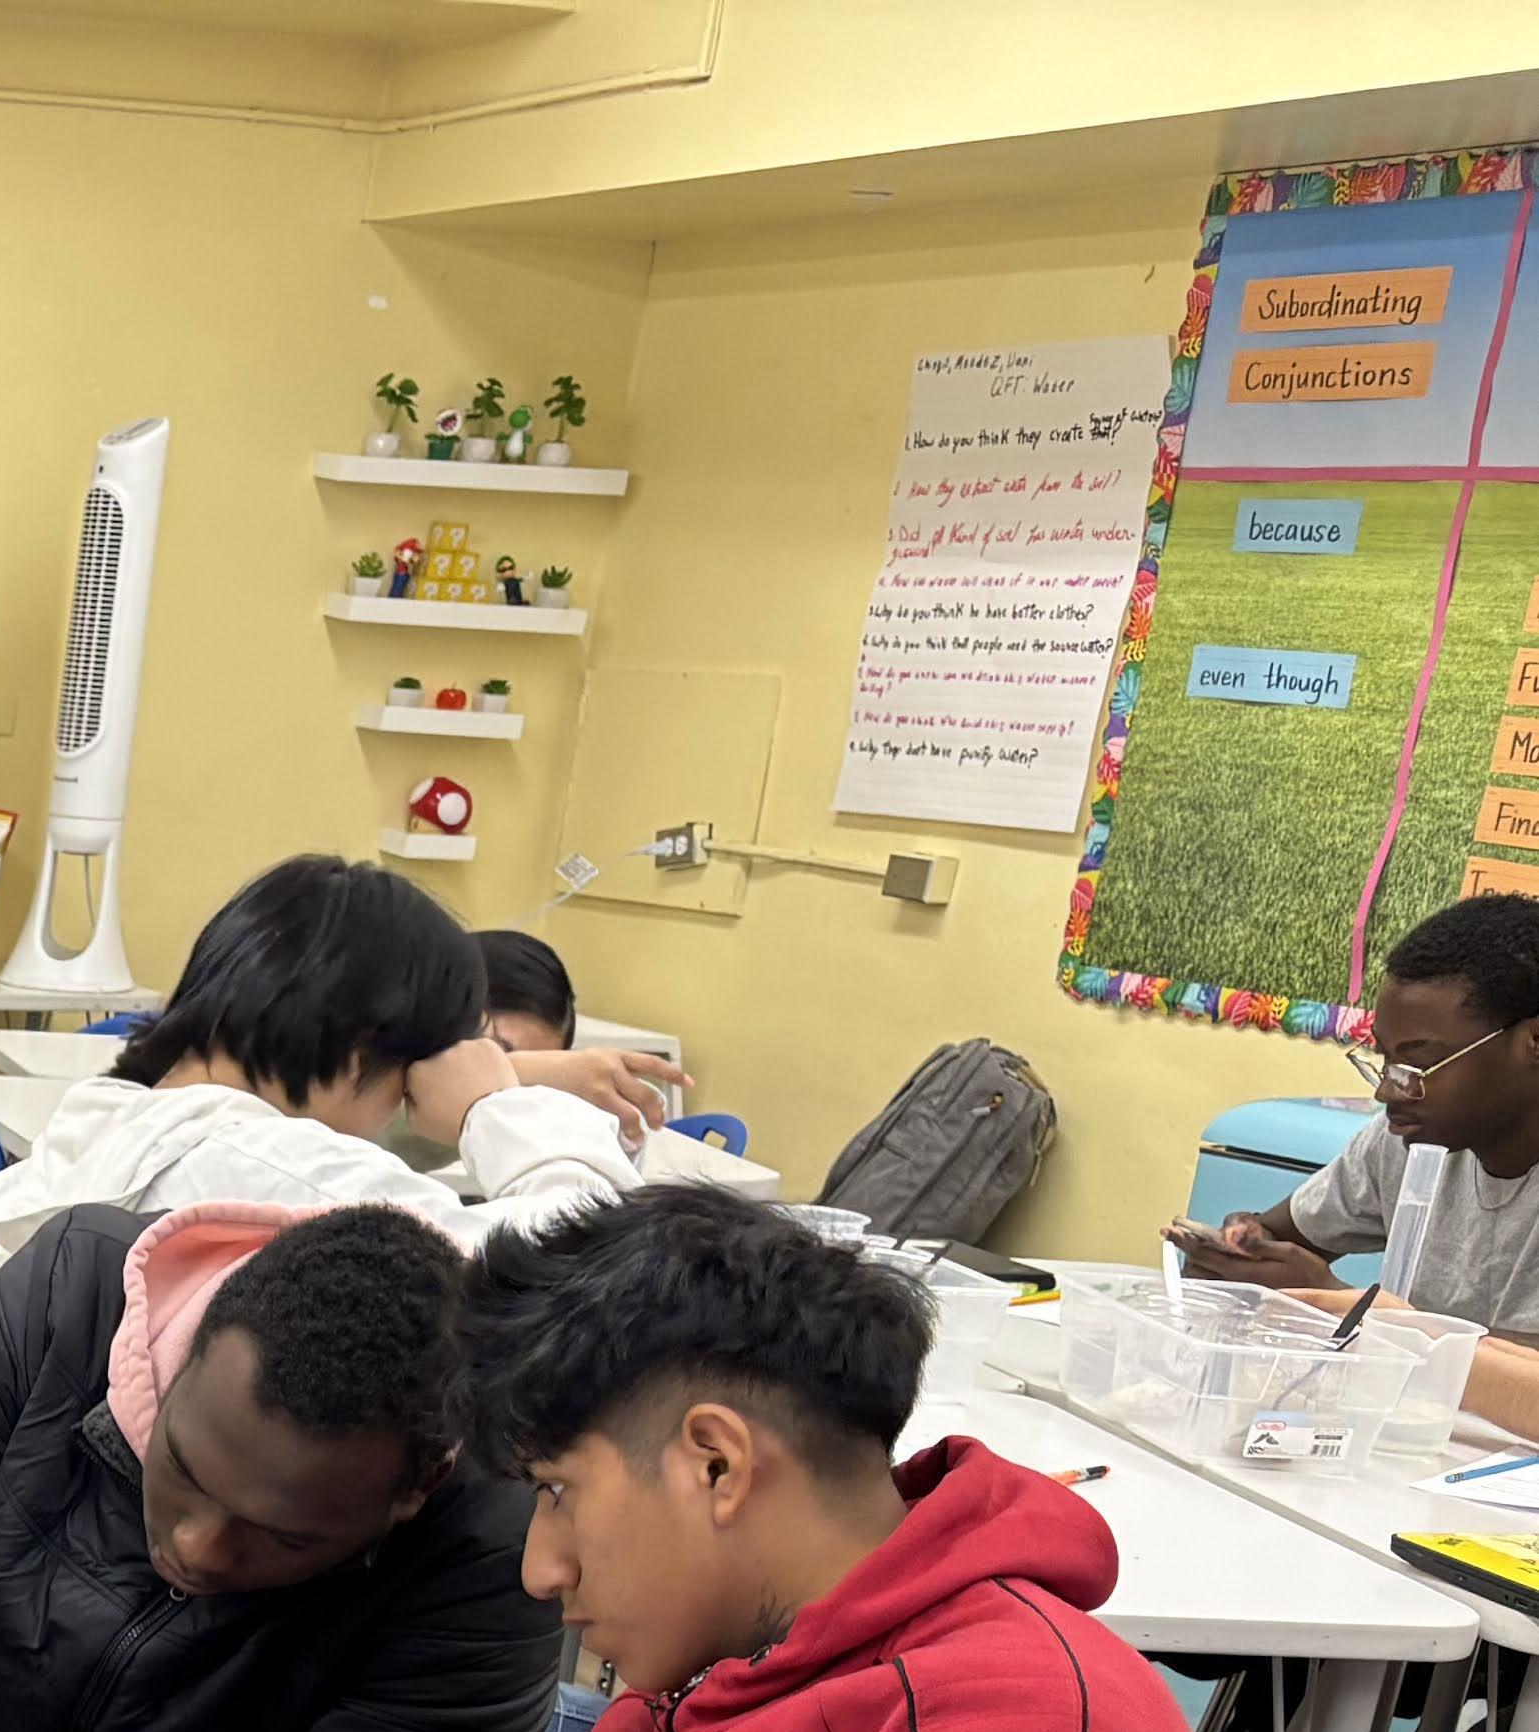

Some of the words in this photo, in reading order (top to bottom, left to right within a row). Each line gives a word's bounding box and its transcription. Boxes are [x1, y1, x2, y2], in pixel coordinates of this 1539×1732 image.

[1258, 284, 1424, 326] Subordinating
[1244, 360, 1414, 400] Conjunctions
[1248, 511, 1342, 543] because
[1199, 669, 1246, 689] even
[1263, 661, 1340, 705] though
